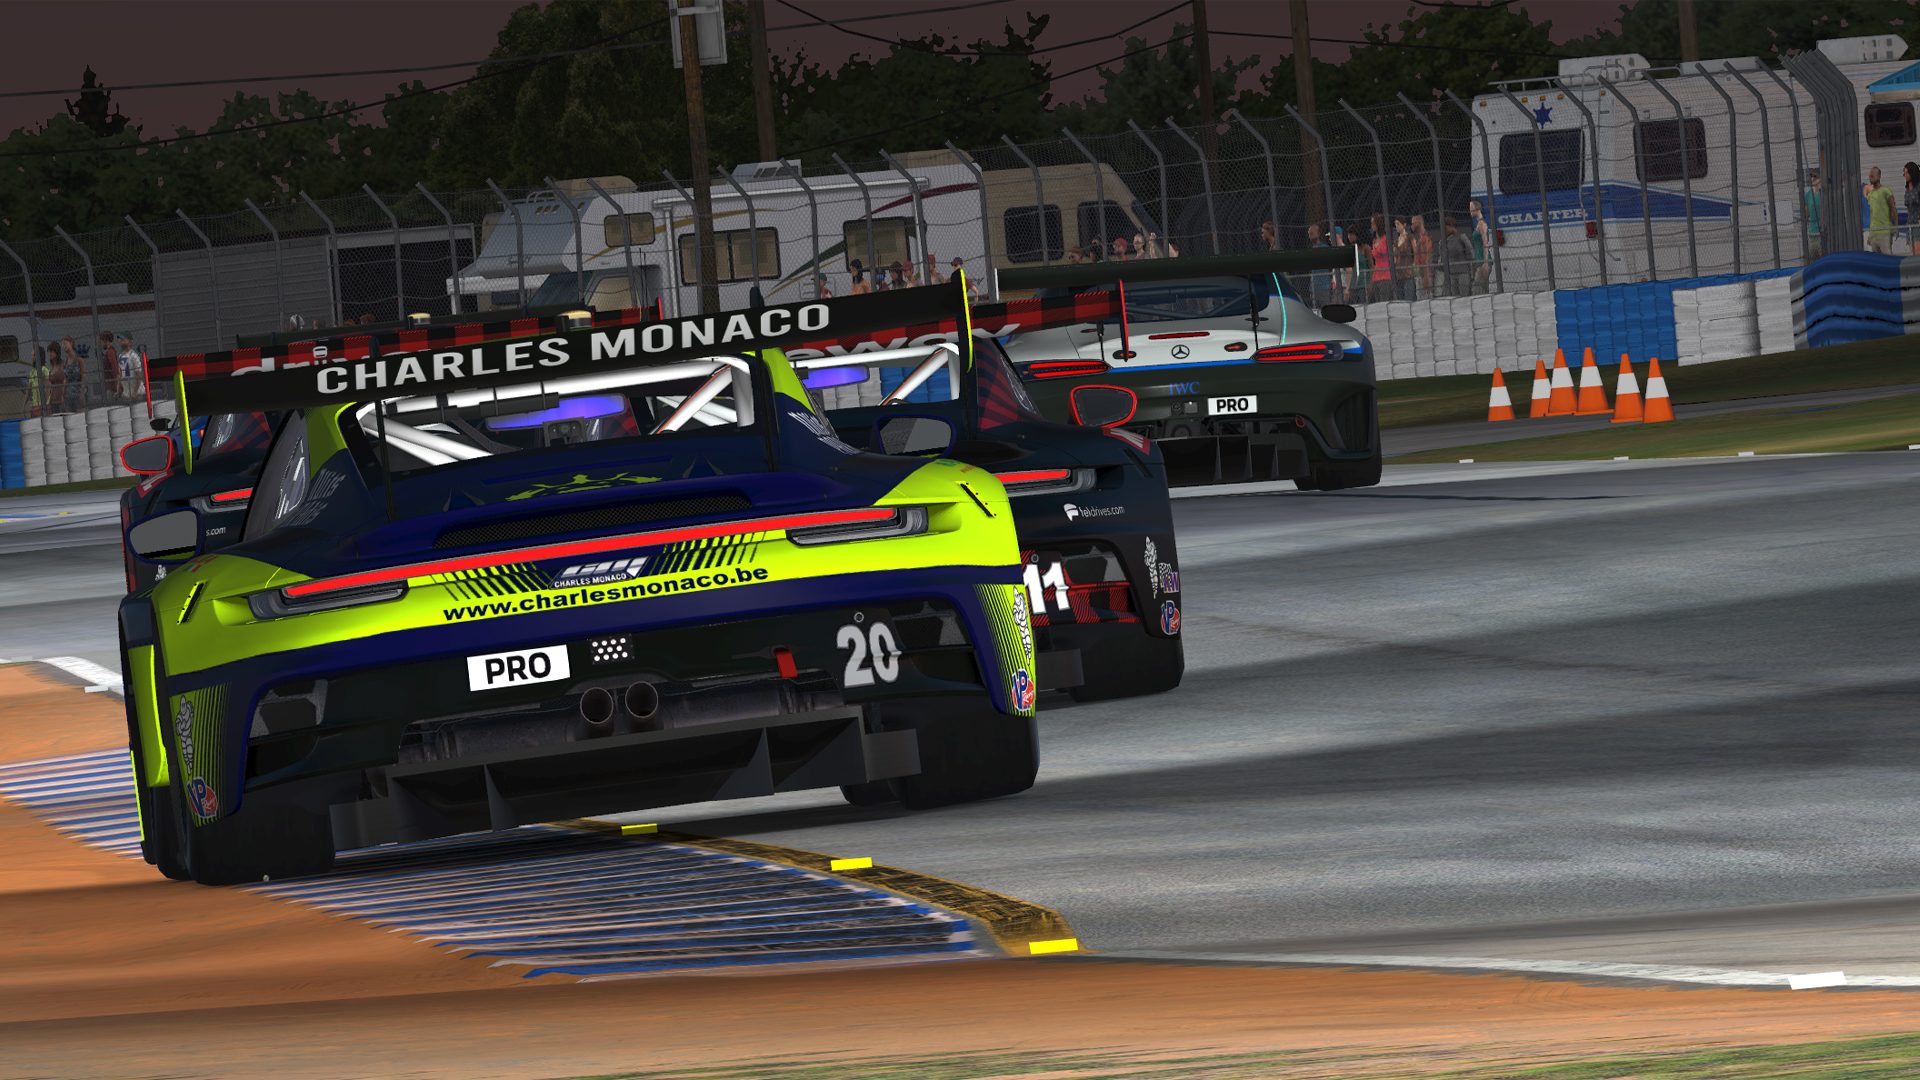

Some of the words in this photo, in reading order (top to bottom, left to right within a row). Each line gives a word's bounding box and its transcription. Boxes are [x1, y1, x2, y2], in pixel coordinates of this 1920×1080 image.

[317, 337, 570, 394] CHARLES
[591, 303, 830, 361] MONACO
[1168, 381, 1200, 396] IWC
[1216, 397, 1249, 413] PRO
[443, 566, 769, 621] www.charlesmonaco.be
[554, 577, 591, 588] CHARLES
[592, 573, 627, 585] MONACO
[1024, 562, 1070, 614] 11
[485, 652, 551, 685] PRO
[836, 622, 902, 688] 20
